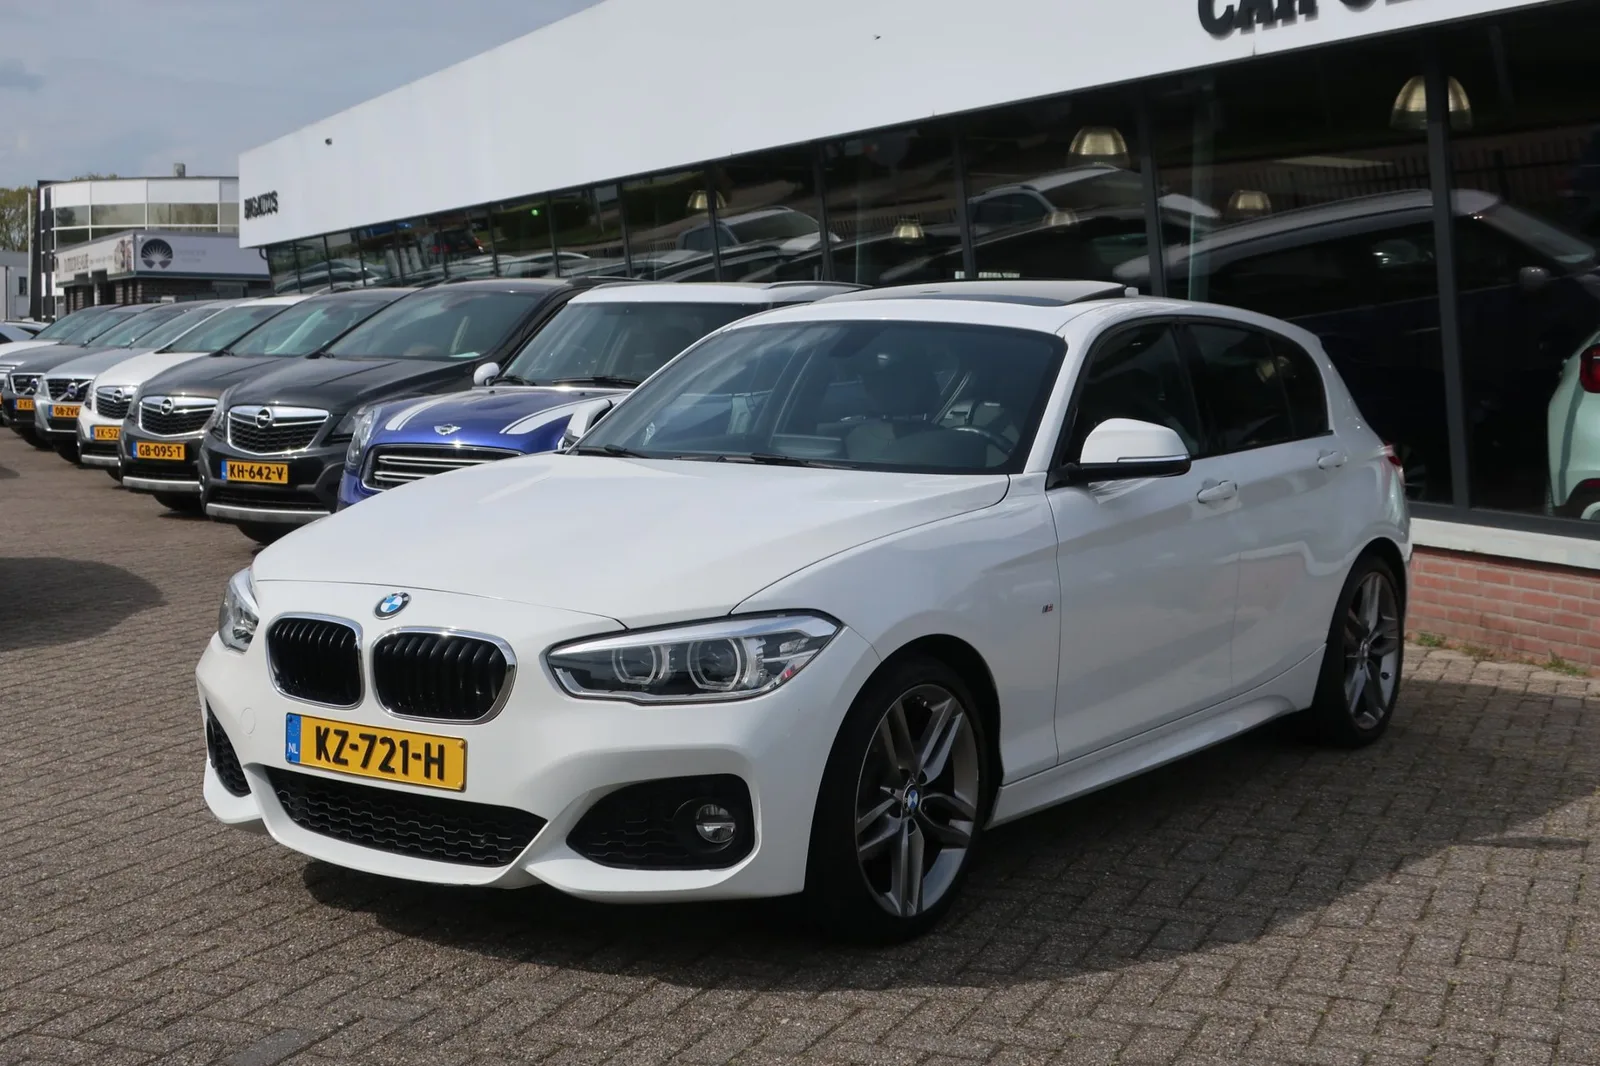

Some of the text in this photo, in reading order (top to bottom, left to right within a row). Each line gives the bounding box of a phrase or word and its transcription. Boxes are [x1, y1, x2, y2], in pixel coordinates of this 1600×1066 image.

[96, 427, 120, 438] XK-52
[139, 444, 182, 458] GB-095-T
[229, 464, 284, 480] KH-642-V
[288, 742, 299, 755] NL
[315, 725, 445, 781] KZ-721-H
